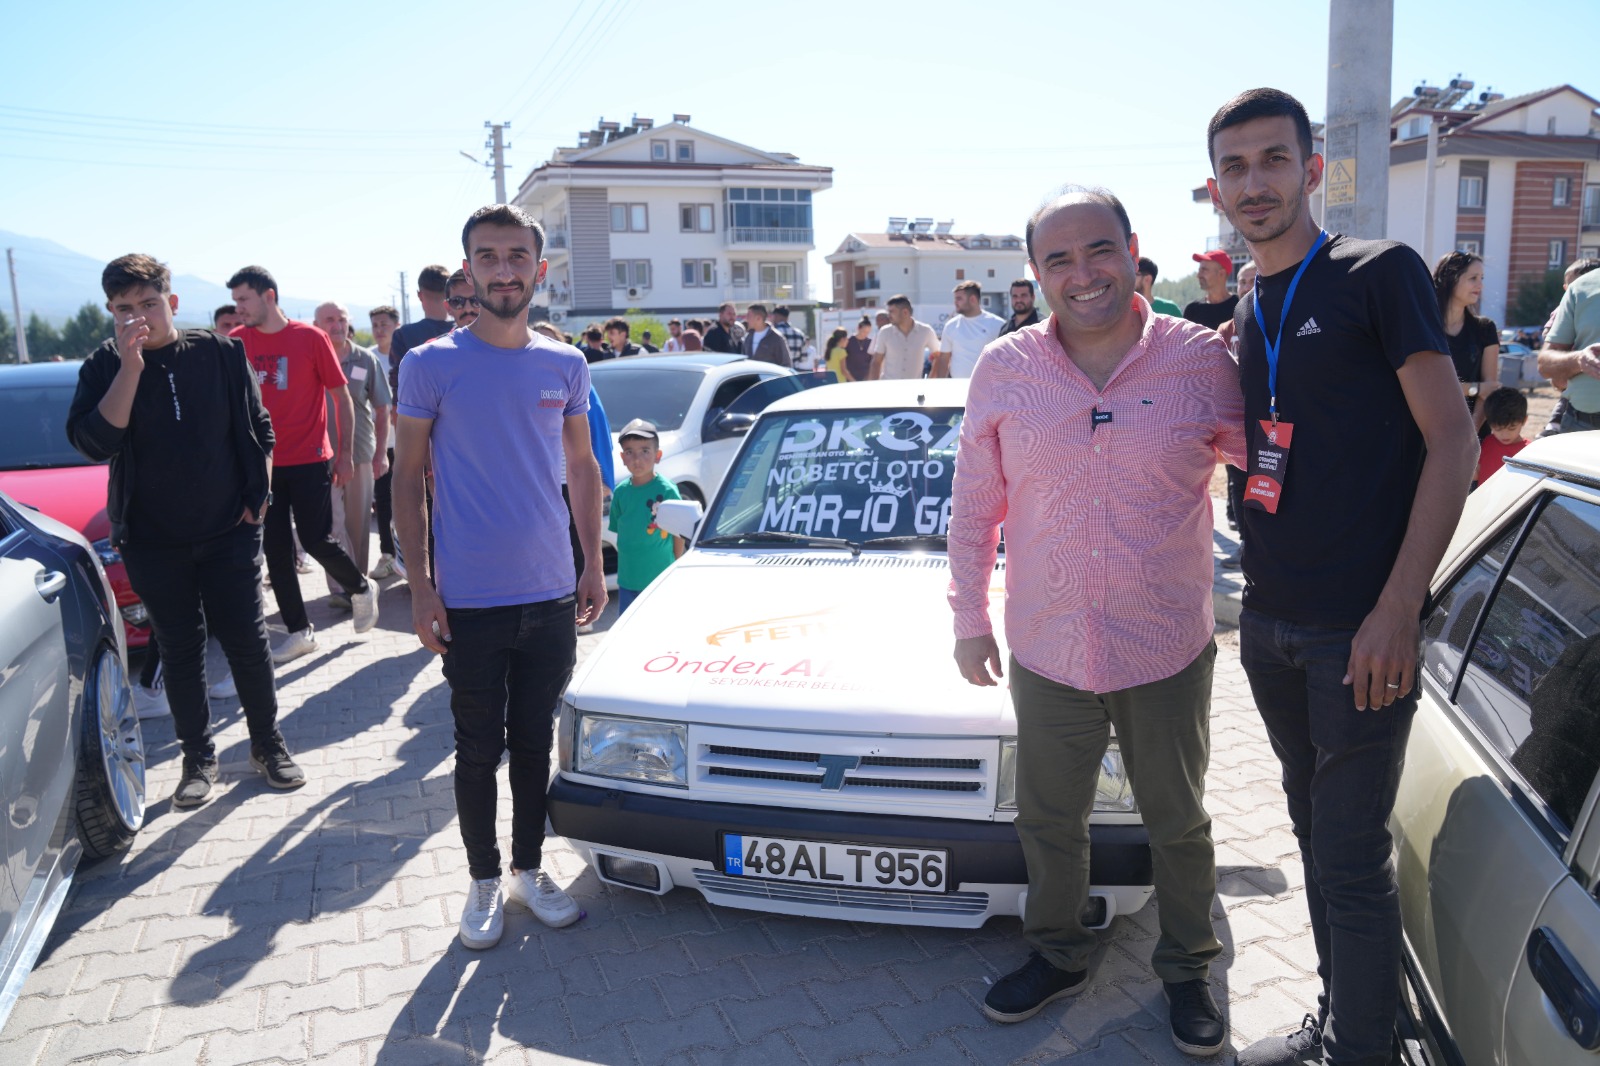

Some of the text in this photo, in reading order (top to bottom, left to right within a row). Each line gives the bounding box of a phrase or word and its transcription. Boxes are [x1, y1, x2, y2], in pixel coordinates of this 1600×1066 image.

[1296, 327, 1321, 337] adidas
[767, 456, 944, 487] NÖBETÇİ OTO
[643, 651, 774, 675] Önder
[708, 676, 808, 689] SEYDİKEMER
[727, 856, 741, 868] TR
